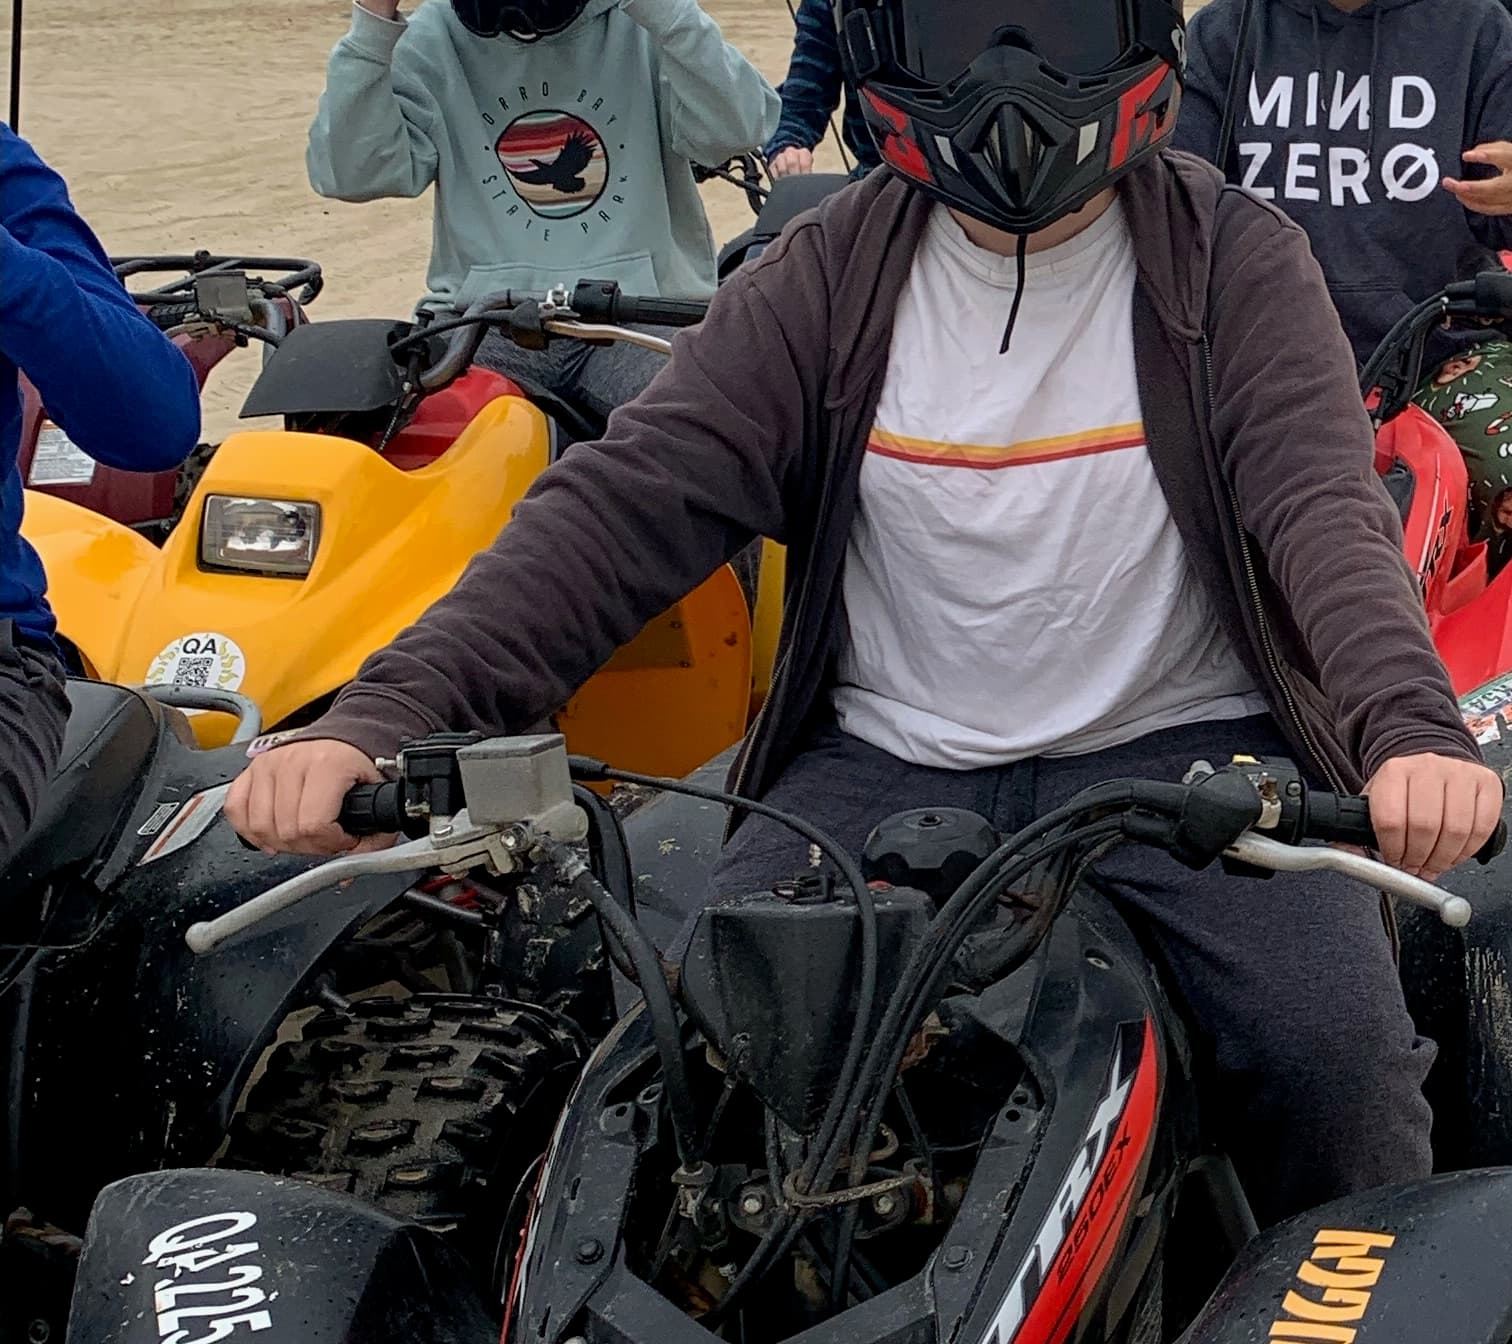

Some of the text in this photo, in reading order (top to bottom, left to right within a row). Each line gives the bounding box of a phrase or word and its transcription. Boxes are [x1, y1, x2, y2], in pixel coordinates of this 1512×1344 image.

[482, 81, 617, 126] ORRO BAY
[482, 175, 628, 241] STATE PARK
[183, 638, 217, 655] QA
[1057, 1122, 1131, 1285] 250EX
